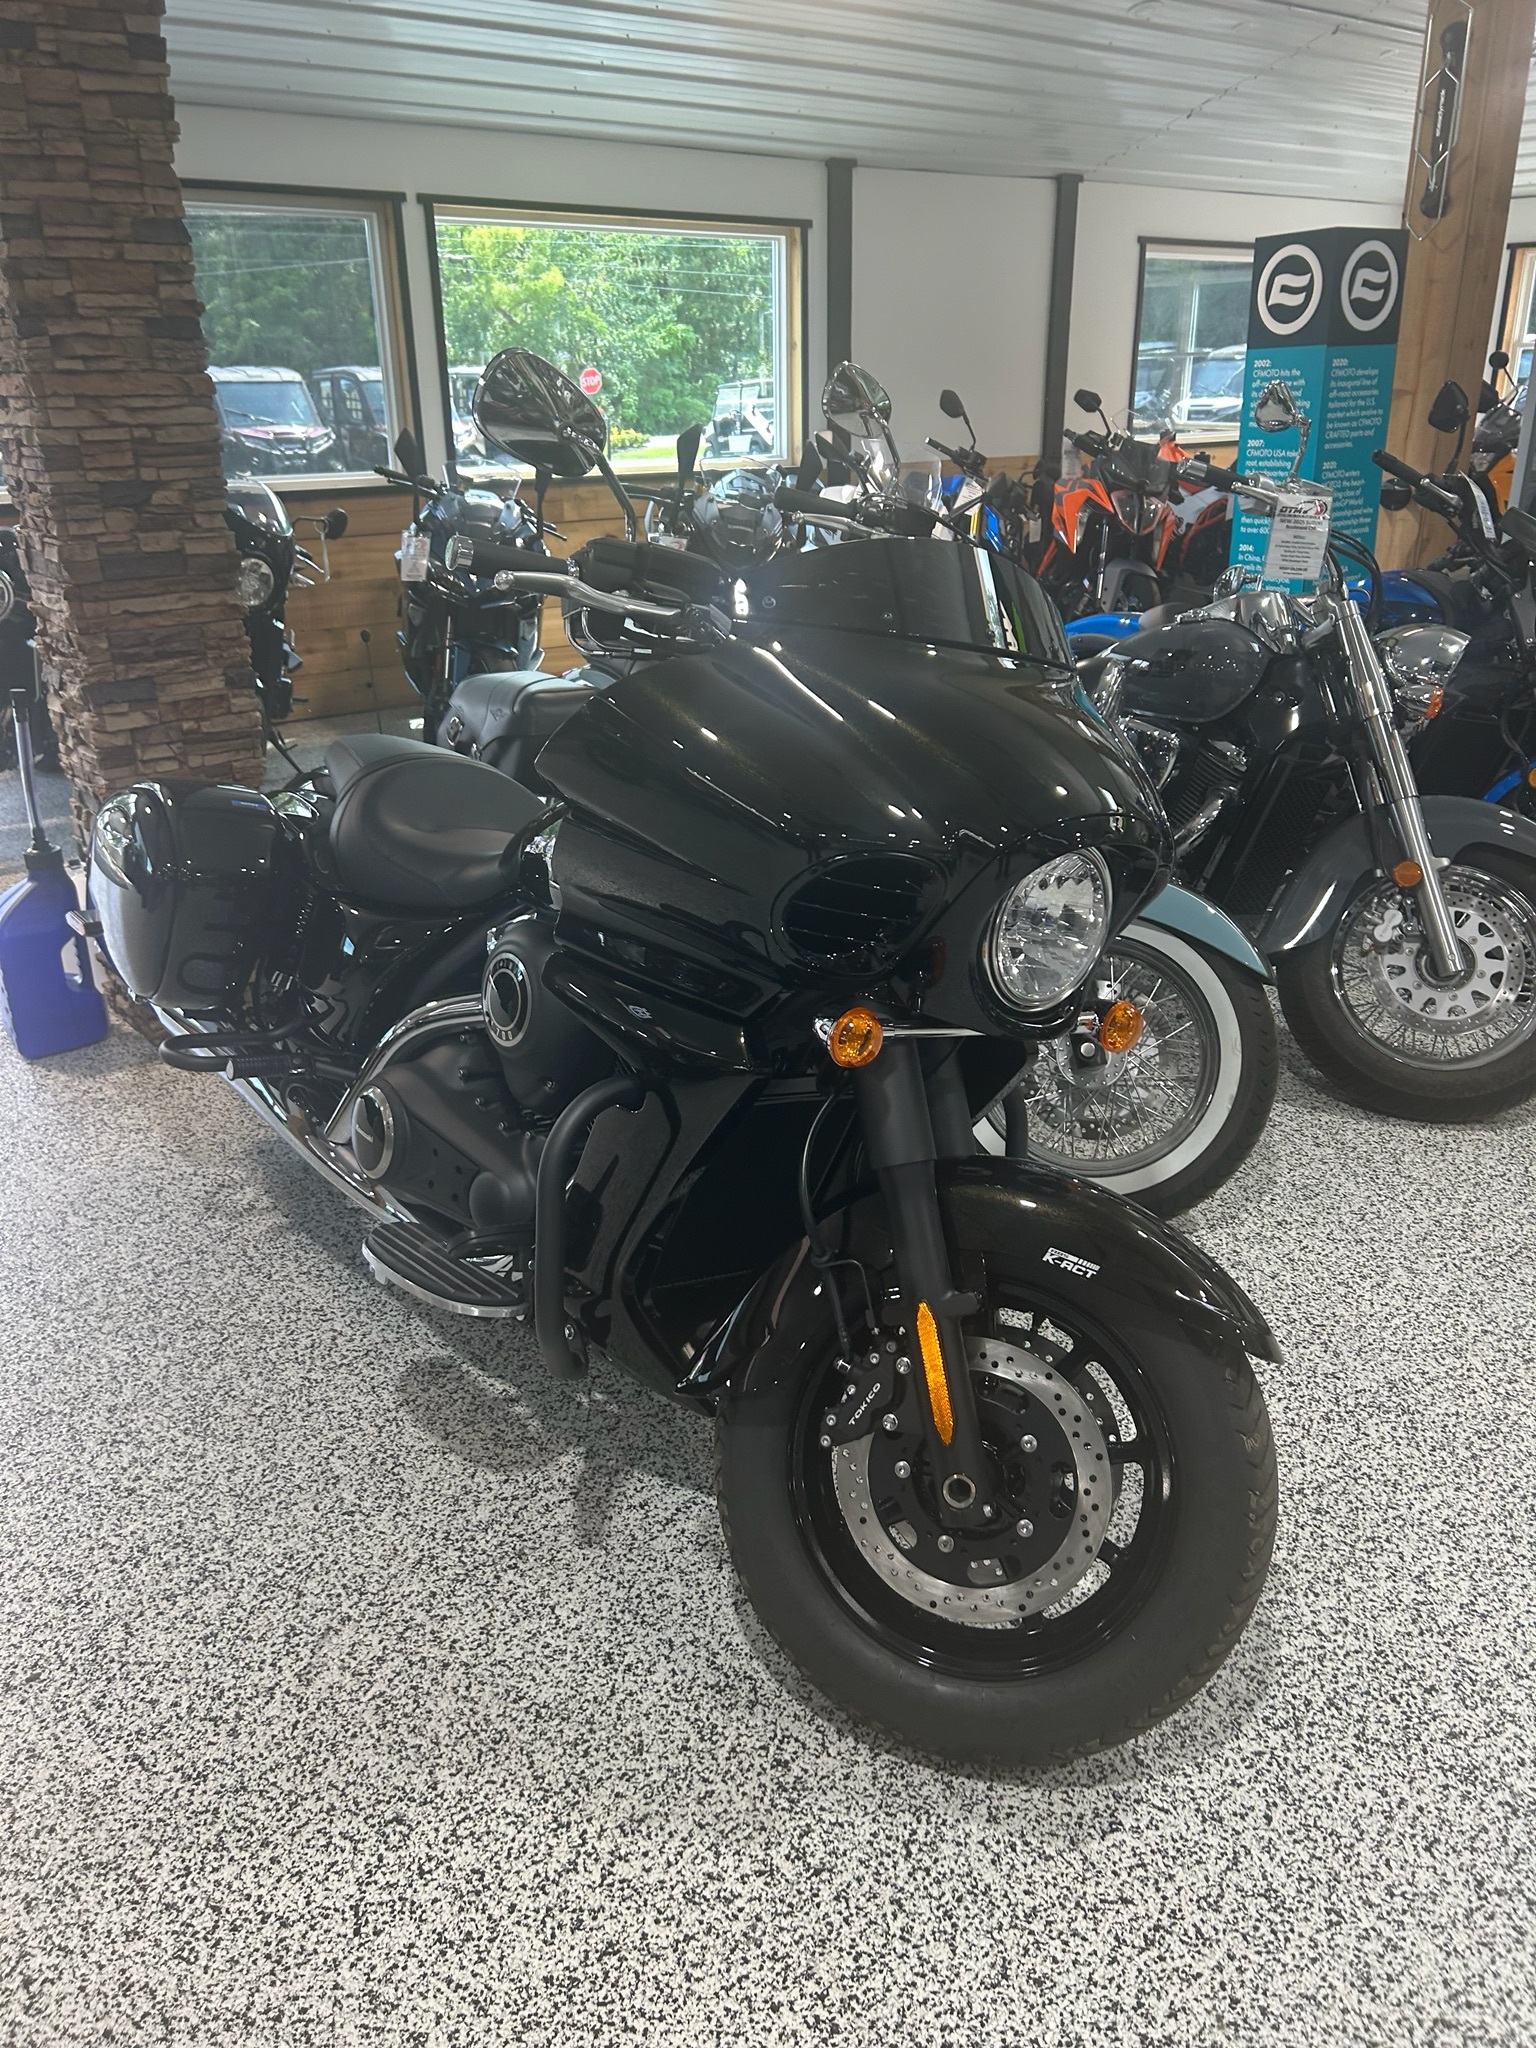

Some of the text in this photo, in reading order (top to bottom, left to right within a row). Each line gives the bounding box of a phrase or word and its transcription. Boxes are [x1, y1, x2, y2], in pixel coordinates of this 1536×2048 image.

[1253, 359, 1272, 368] 2002:
[1332, 358, 1349, 367] 2020:
[1252, 369, 1280, 378] CFMOTO
[1291, 368, 1301, 377] the
[1331, 368, 1356, 377] CFMOTO
[580, 375, 600, 386] STOP
[1358, 417, 1382, 426] CFMOTO
[1325, 429, 1350, 439] CRAFTED
[1247, 439, 1265, 448] 2007:
[1246, 449, 1272, 458] CFMOTO
[1273, 449, 1286, 458] USA
[1258, 459, 1292, 470] establishing
[1241, 516, 1253, 524] then
[1240, 526, 1246, 534] to
[1239, 544, 1254, 552] 2014:
[1244, 553, 1262, 562] China,
[1042, 1252, 1097, 1279] K-ACT
[848, 1382, 881, 1425] TOKICO
